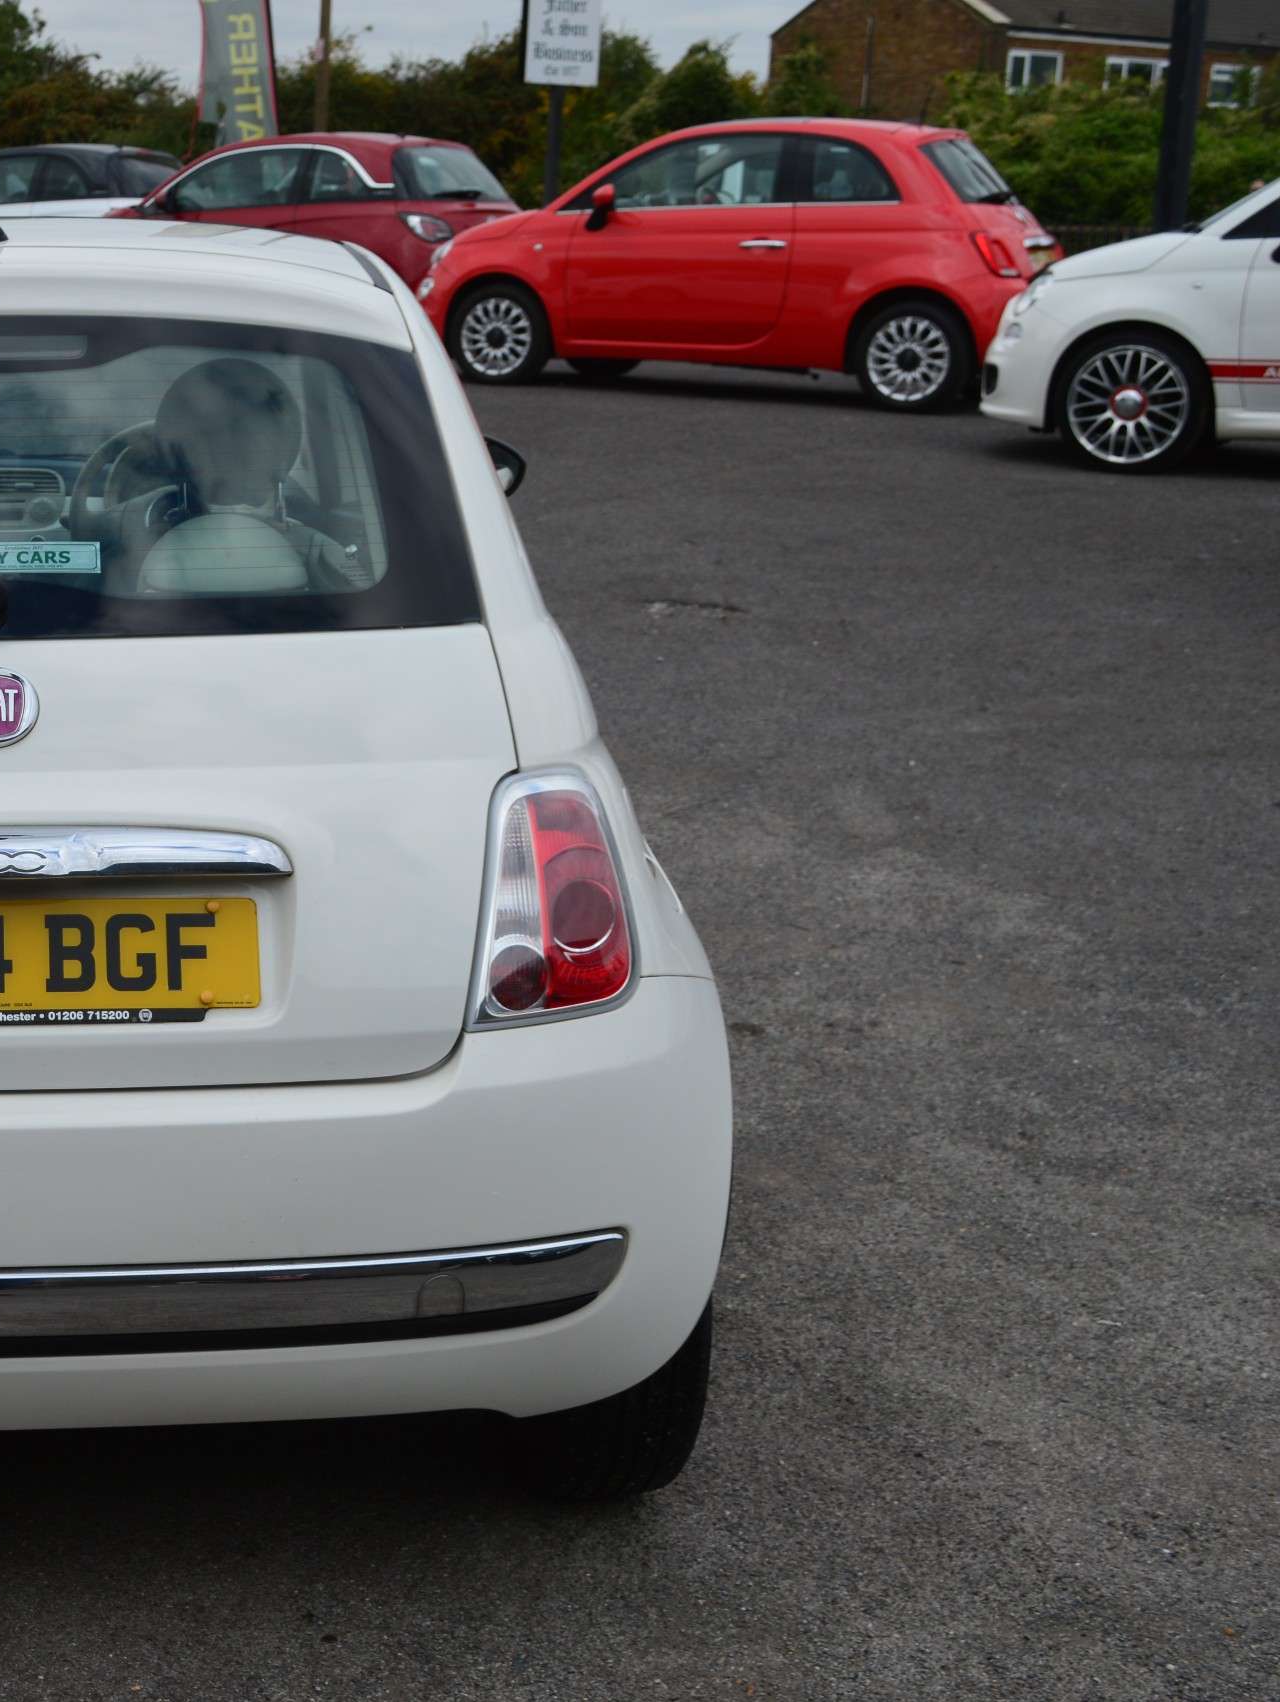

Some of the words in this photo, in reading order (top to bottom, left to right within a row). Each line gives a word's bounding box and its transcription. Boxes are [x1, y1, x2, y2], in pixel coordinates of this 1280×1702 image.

[16, 550, 71, 565] CARS
[44, 912, 216, 993] BGF
[47, 1011, 84, 1021] 01206
[88, 1010, 130, 1020] 715200
